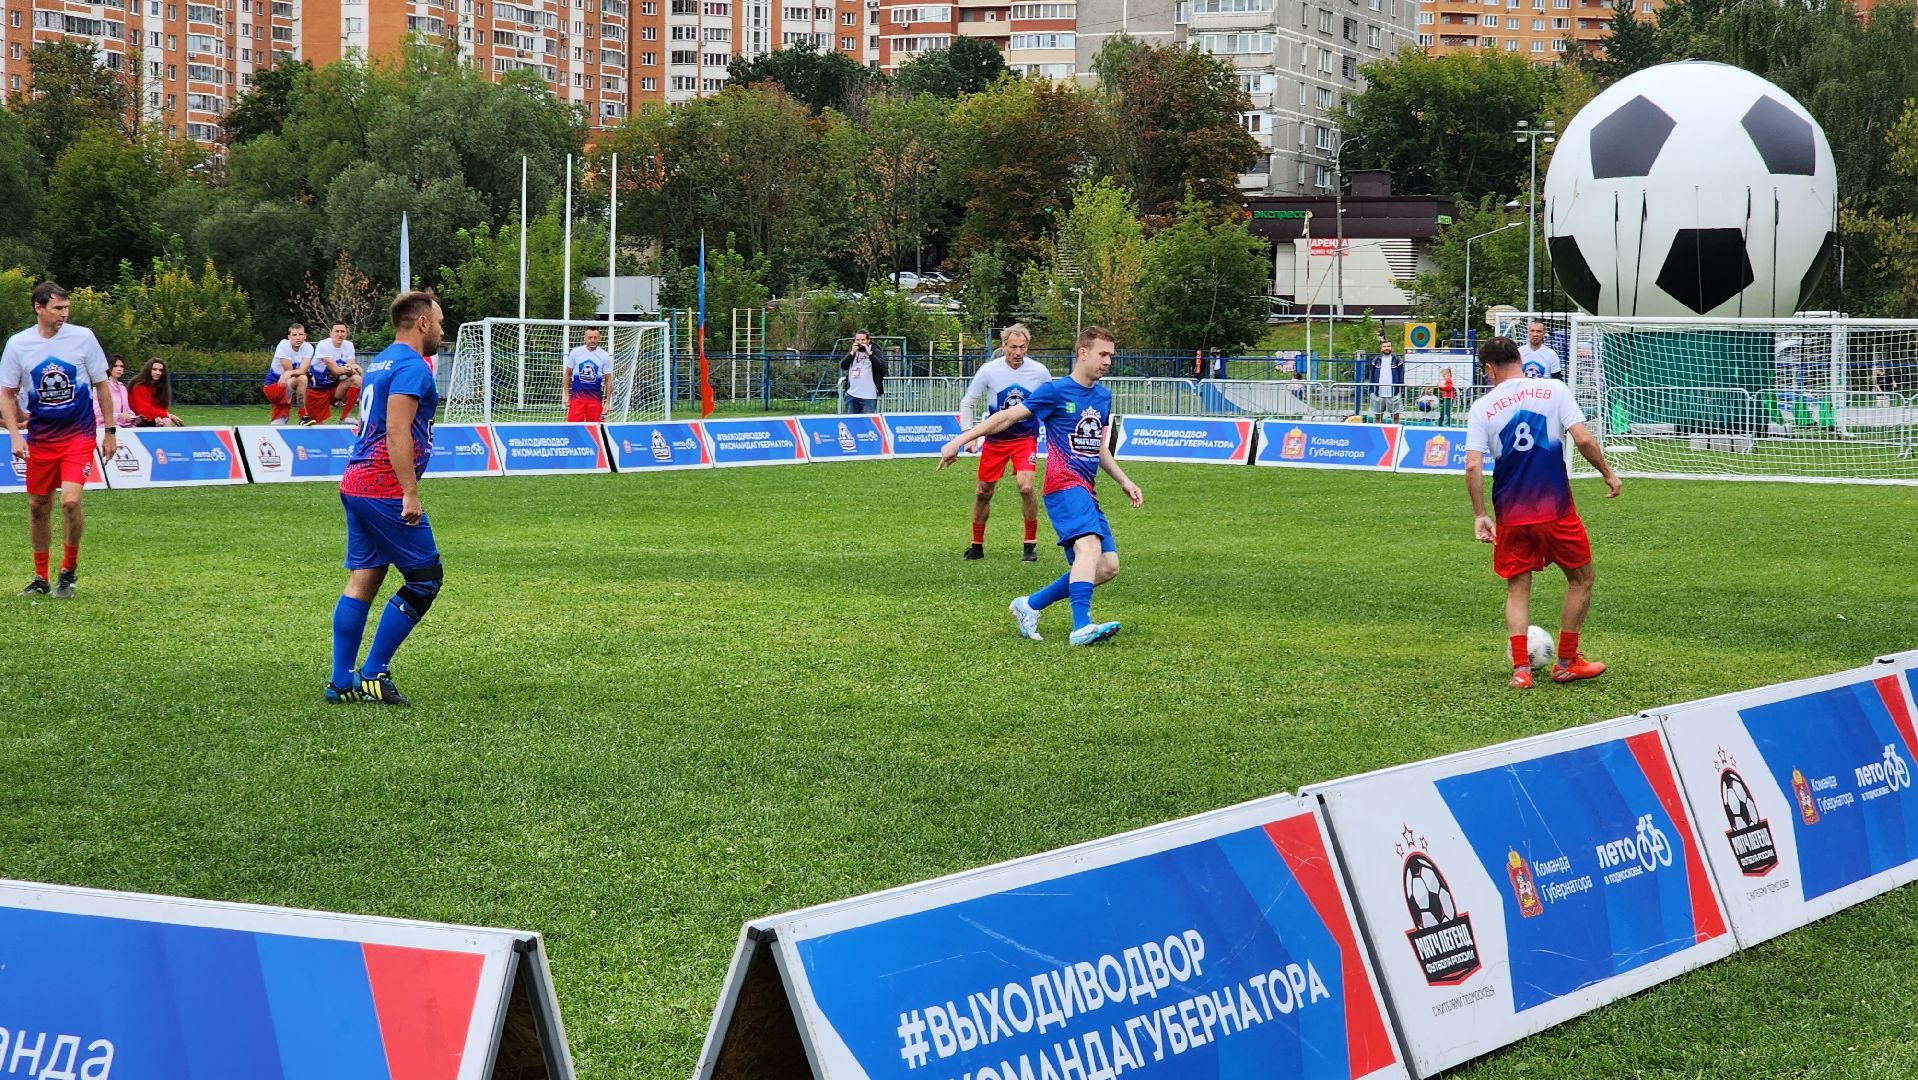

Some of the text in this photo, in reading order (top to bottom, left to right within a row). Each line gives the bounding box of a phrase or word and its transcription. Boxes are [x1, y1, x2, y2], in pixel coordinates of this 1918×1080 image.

[1485, 387, 1553, 421] АЛЕНИЧЕВ
[1131, 438, 1235, 449] #КОМАНДАГУБЕРНАТОРА
[1132, 428, 1208, 440] #ВЫХОДИВОДВОР
[1310, 435, 1350, 447] Команда
[1512, 421, 1535, 452] 8
[512, 447, 596, 458] #КОМАНДАГУБЕРНАТОРА
[1308, 447, 1366, 459] Губернатора
[1854, 762, 1885, 788] лето
[1595, 837, 1638, 869] лето
[1532, 855, 1571, 878] Команда
[1541, 875, 1593, 905] Губернатора
[1414, 923, 1474, 961] МАТЧ ЛЕГЕНД
[897, 929, 1205, 1069] #ВЫХОДИВОДВОР
